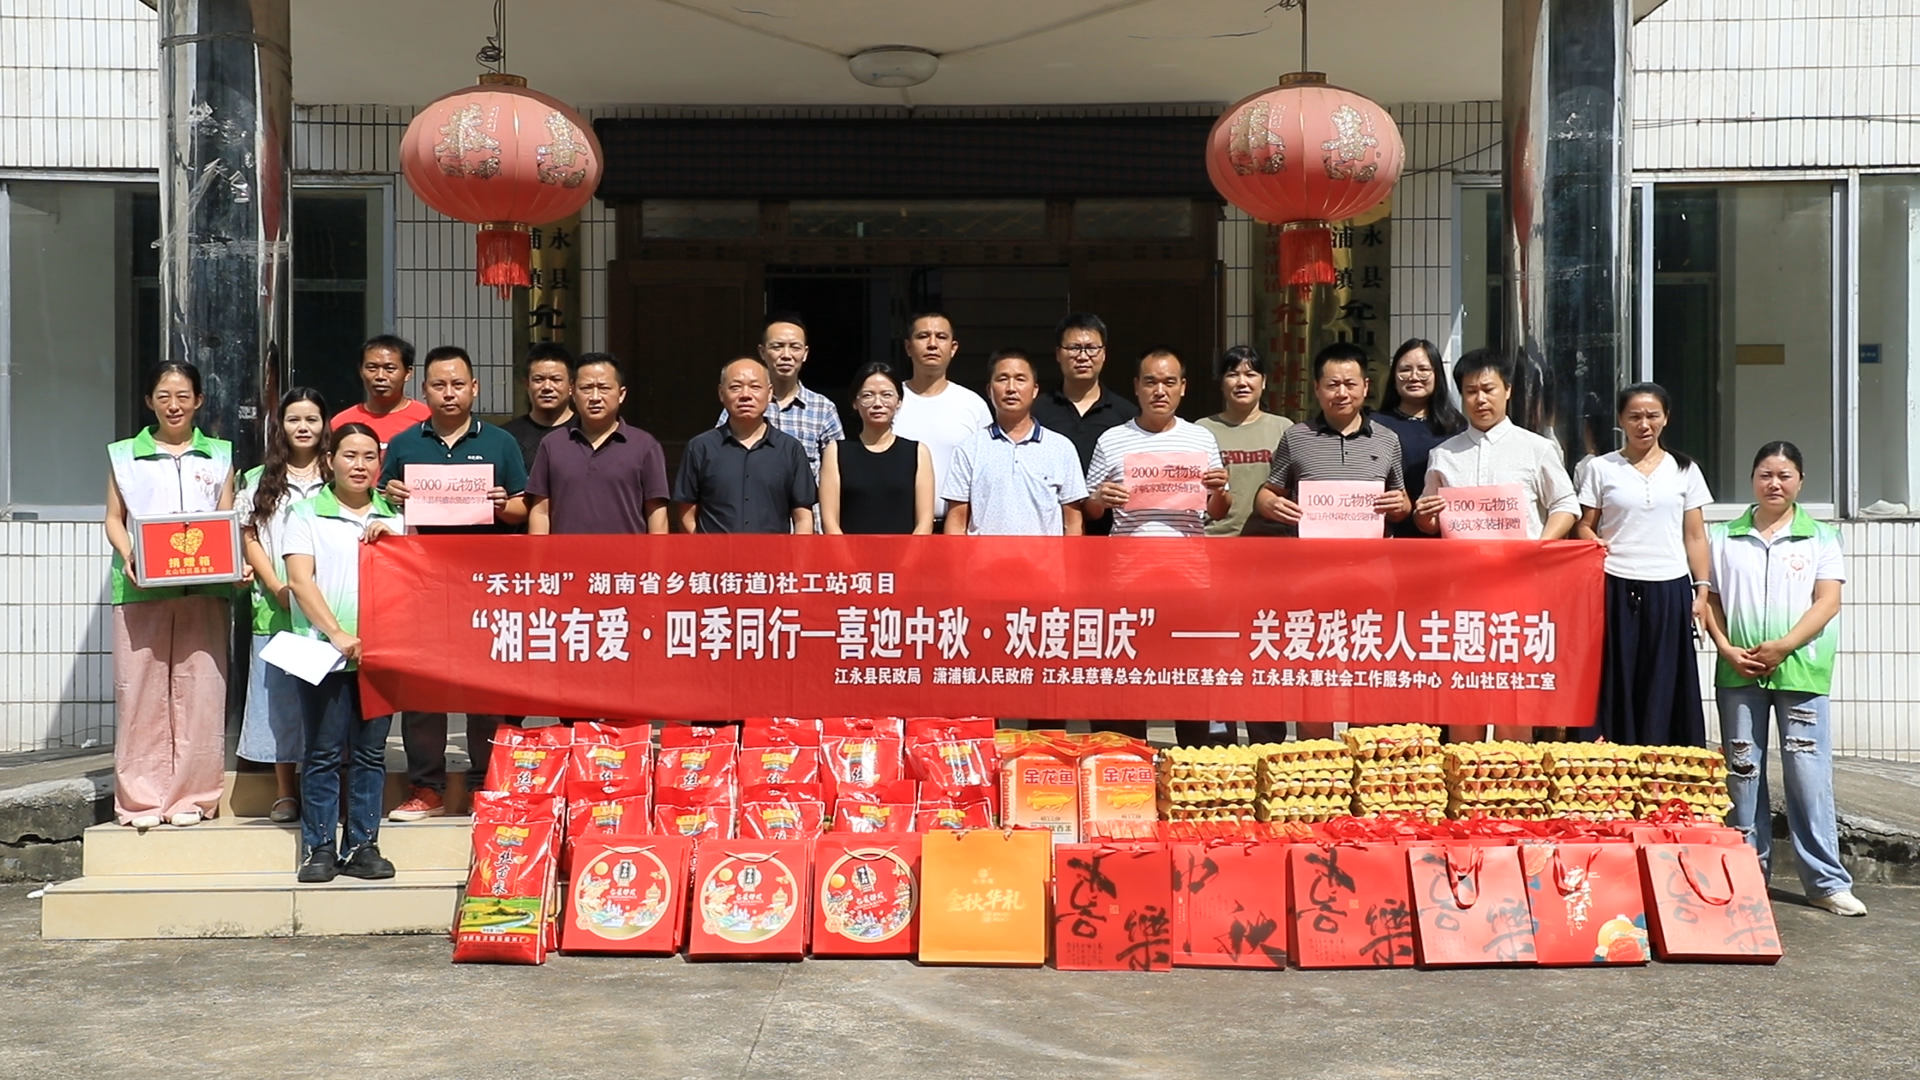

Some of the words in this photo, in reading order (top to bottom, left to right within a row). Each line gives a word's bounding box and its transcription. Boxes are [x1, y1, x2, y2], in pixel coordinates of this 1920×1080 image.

[549, 228, 571, 291] 永县
[1361, 225, 1384, 290] 永县
[168, 556, 211, 568] 捐赠箱
[472, 572, 574, 596] “禾计划”
[588, 571, 895, 595] 湖南省乡镇(街道)社工站项目
[834, 667, 921, 685] 江永县民政局
[932, 667, 1034, 685] 潇浦镇人民政府
[1042, 667, 1244, 686] 江永县慈善总会允山社区基金会
[1251, 668, 1443, 688] 江永县永惠社会工作服务中心
[1450, 671, 1557, 691] 允山社区社工室
[1023, 768, 1074, 785] 金龙鱼
[1102, 767, 1154, 784] 金龙鱼
[492, 847, 515, 897] 丝苗米
[946, 887, 1027, 913] 金秋华礼
